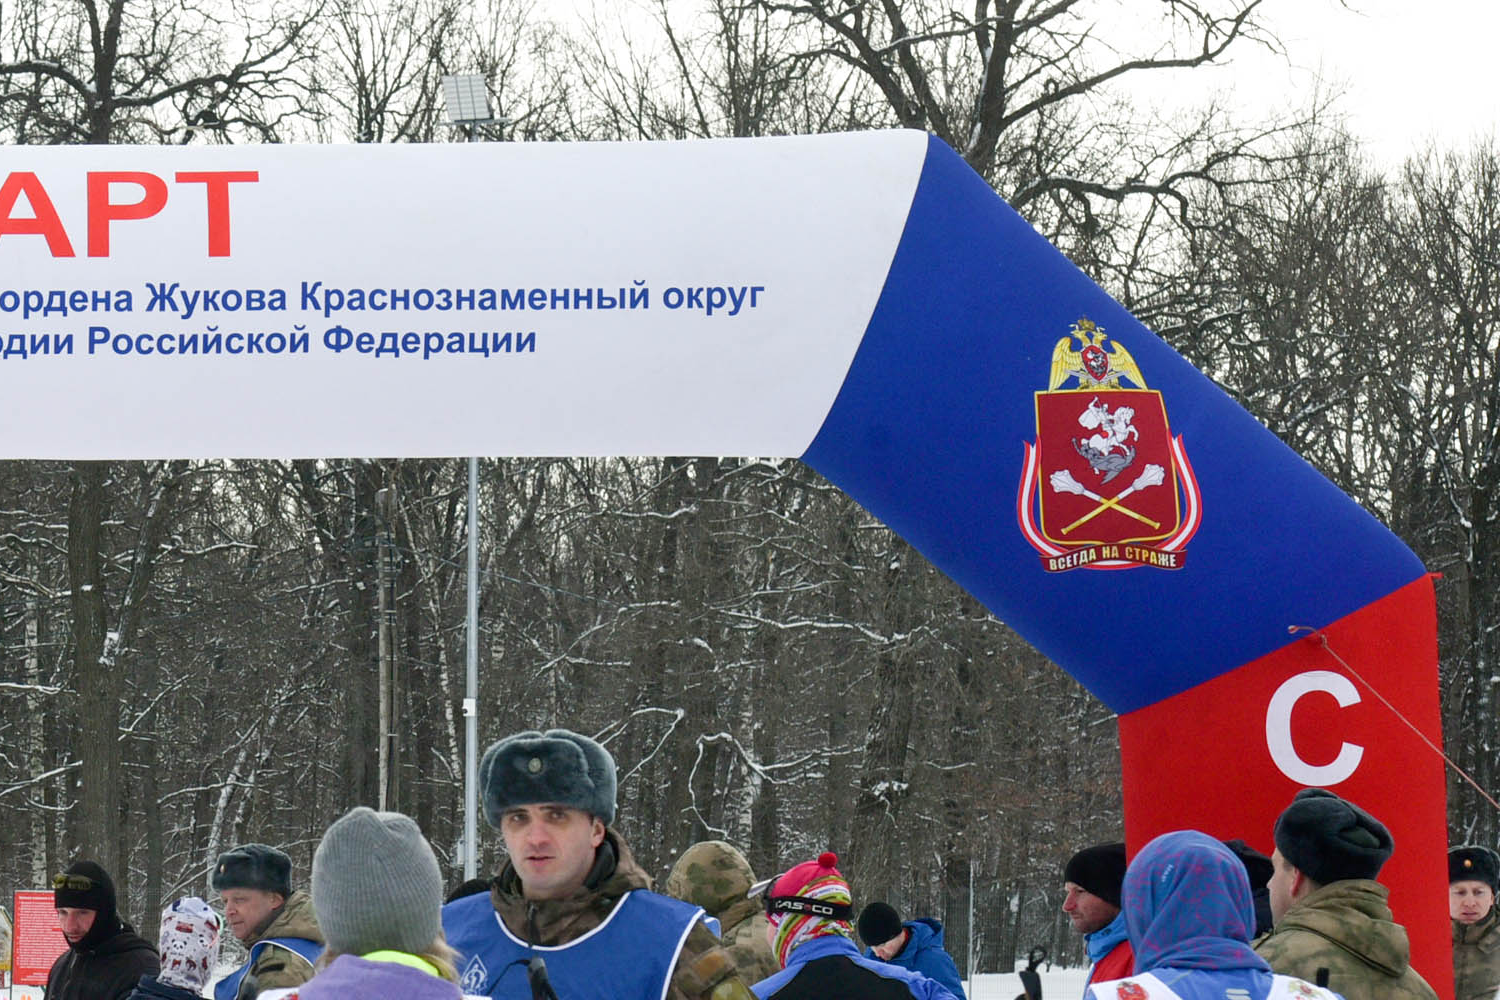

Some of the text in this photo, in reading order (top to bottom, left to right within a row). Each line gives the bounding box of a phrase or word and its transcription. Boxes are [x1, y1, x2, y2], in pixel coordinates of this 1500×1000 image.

[0, 290, 134, 320] ордена
[145, 283, 287, 320] Жукова
[301, 280, 650, 318] Краснознаменный
[663, 286, 765, 317] округ
[88, 325, 310, 355] Российской
[323, 325, 536, 360] Федерации
[1049, 546, 1176, 571] ВСЕГДА НА СТРАЖЕ
